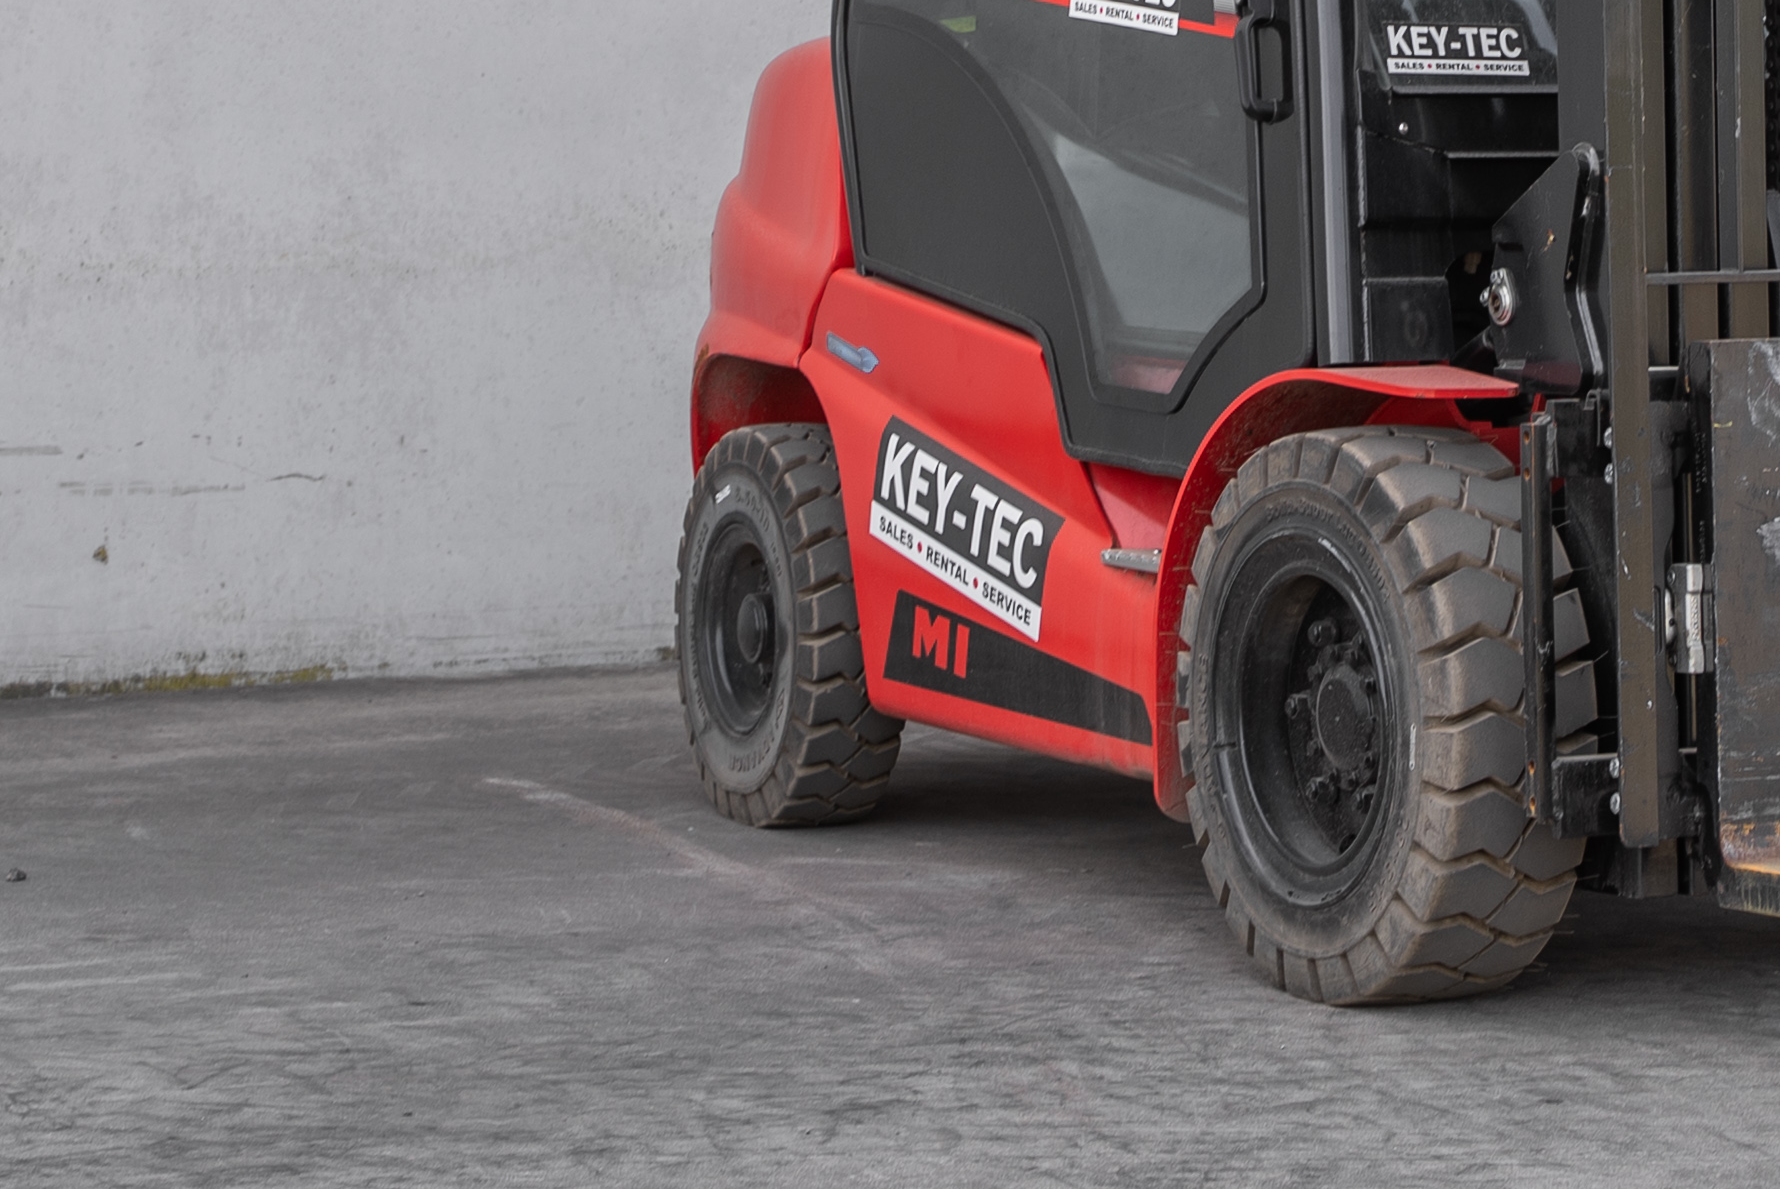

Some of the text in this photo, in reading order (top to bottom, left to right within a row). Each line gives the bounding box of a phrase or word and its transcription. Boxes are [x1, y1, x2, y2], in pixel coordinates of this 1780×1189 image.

[1074, 1, 1175, 29] SALES RENTAL SERVICE
[1386, 25, 1522, 58] KEY-TEC
[1394, 62, 1525, 72] SALES RENTAL SERVICE
[880, 432, 1044, 589] KEY-TEC
[879, 516, 1032, 627] SALES RENTAL SERVICE
[912, 605, 970, 679] MI
